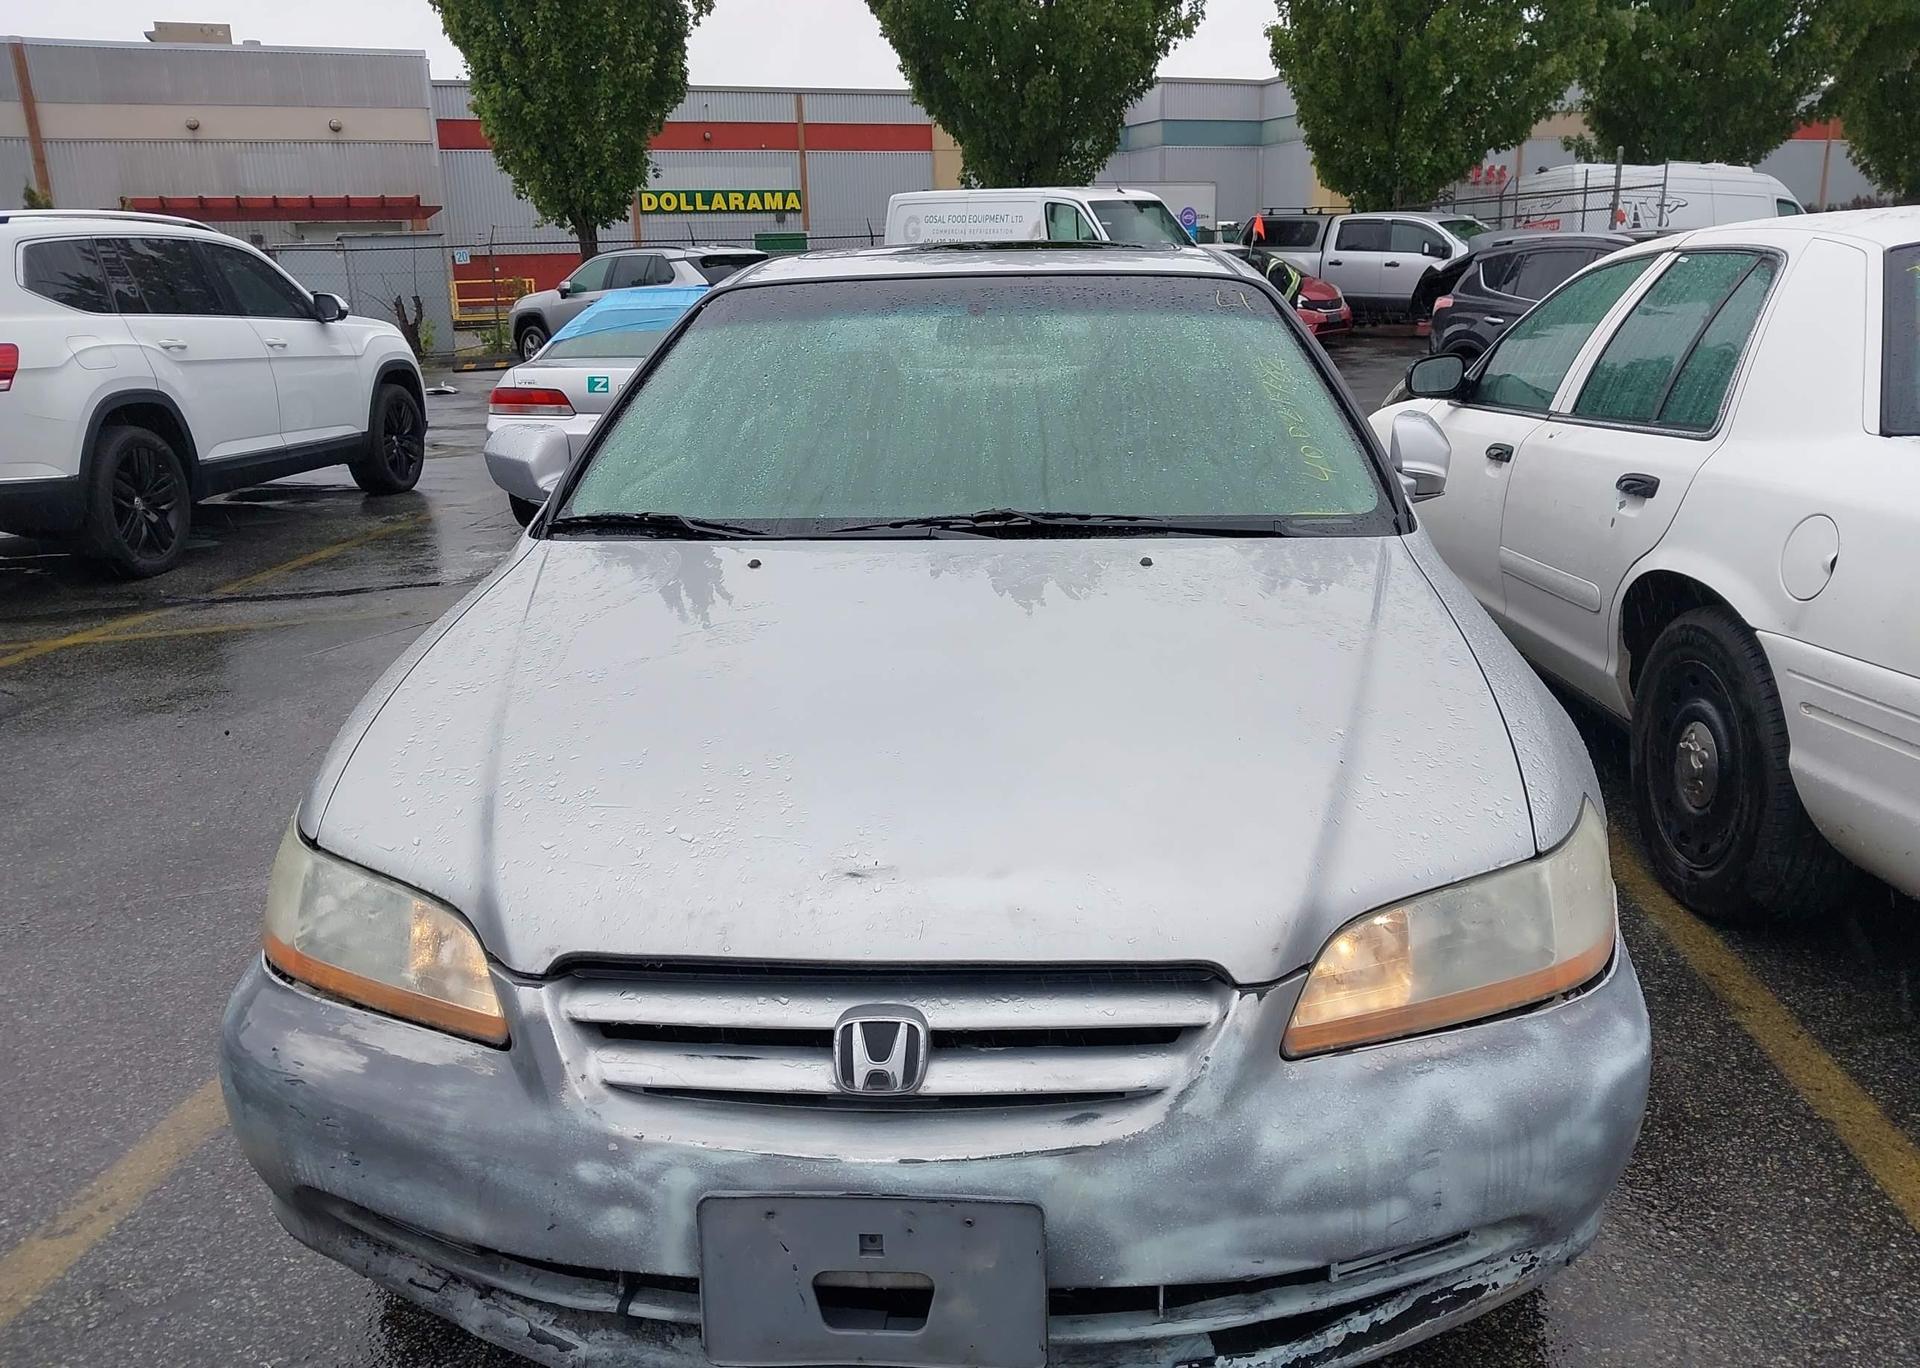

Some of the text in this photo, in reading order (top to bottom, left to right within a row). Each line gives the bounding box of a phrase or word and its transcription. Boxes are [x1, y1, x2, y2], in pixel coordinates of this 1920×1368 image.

[641, 192, 801, 211] DOLLARAMA
[924, 214, 946, 224] GOSAL
[948, 214, 967, 224] FOOD
[968, 213, 1010, 224] EQUIPMENT
[455, 251, 468, 263] 20
